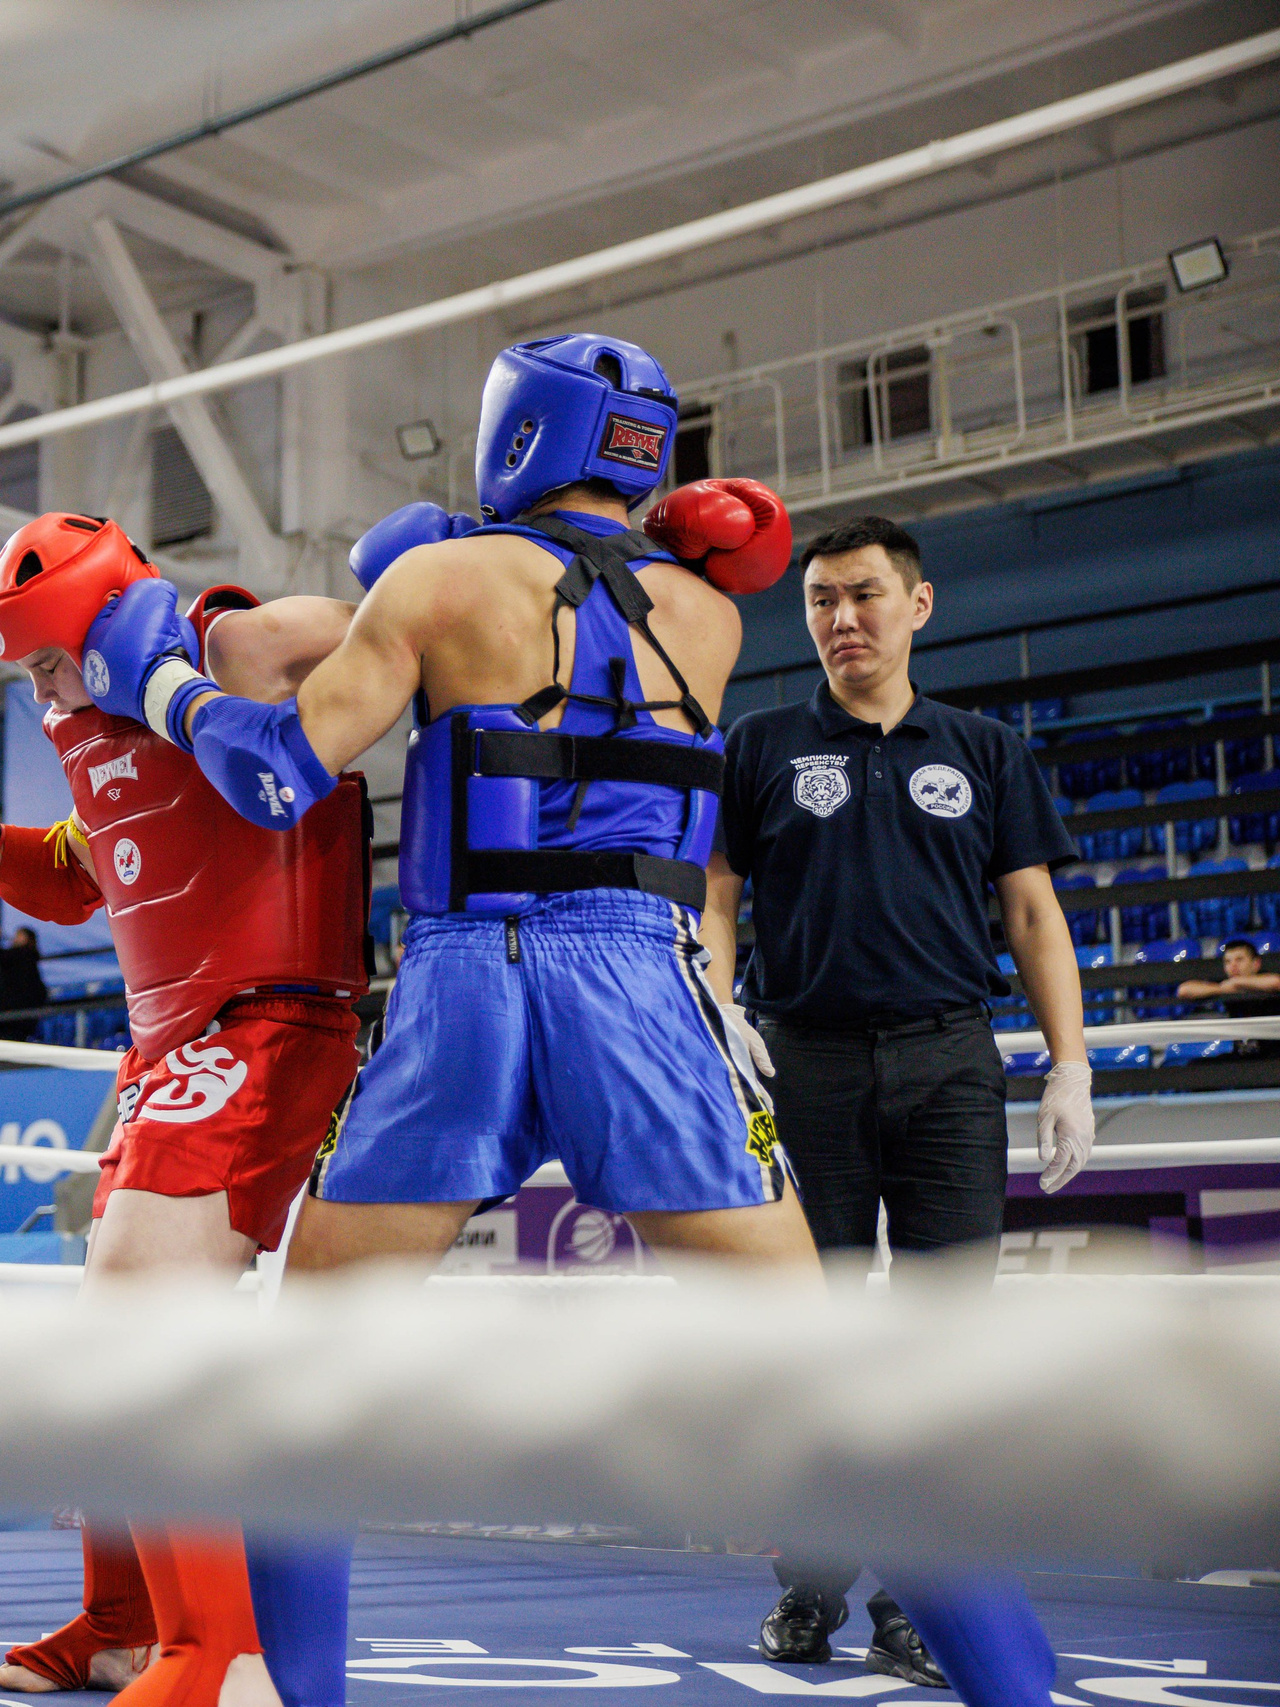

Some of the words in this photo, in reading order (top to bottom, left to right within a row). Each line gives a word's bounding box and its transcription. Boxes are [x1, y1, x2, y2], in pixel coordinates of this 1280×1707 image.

[790, 754, 850, 765] ЧЕМПИОНАТ
[795, 760, 846, 770] ПЕРВЕНСТВО
[813, 806, 833, 816] 2024
